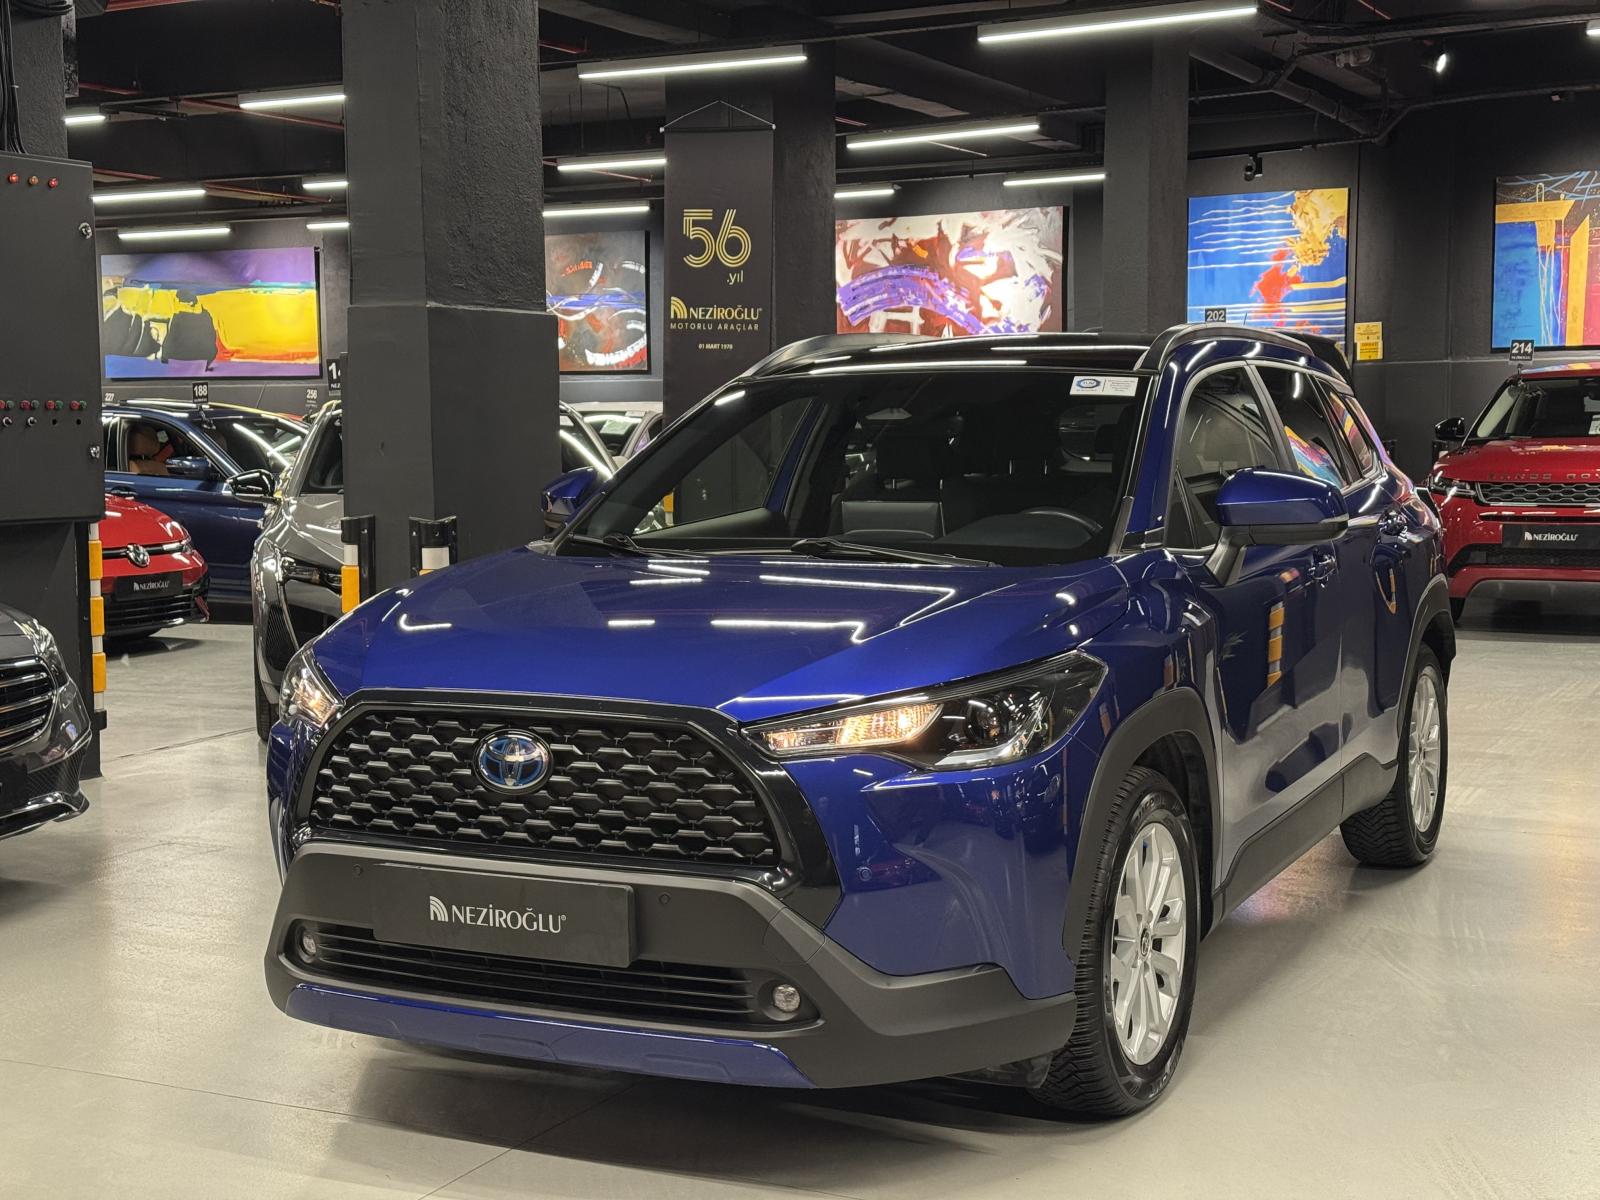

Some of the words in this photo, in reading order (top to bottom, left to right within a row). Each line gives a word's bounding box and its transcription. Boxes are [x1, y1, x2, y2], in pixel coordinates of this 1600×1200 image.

[683, 208, 752, 268] 56
[1206, 310, 1225, 321] 202
[717, 323, 759, 332] ARAÇLAR
[1511, 342, 1533, 354] 214
[193, 385, 208, 397] 188
